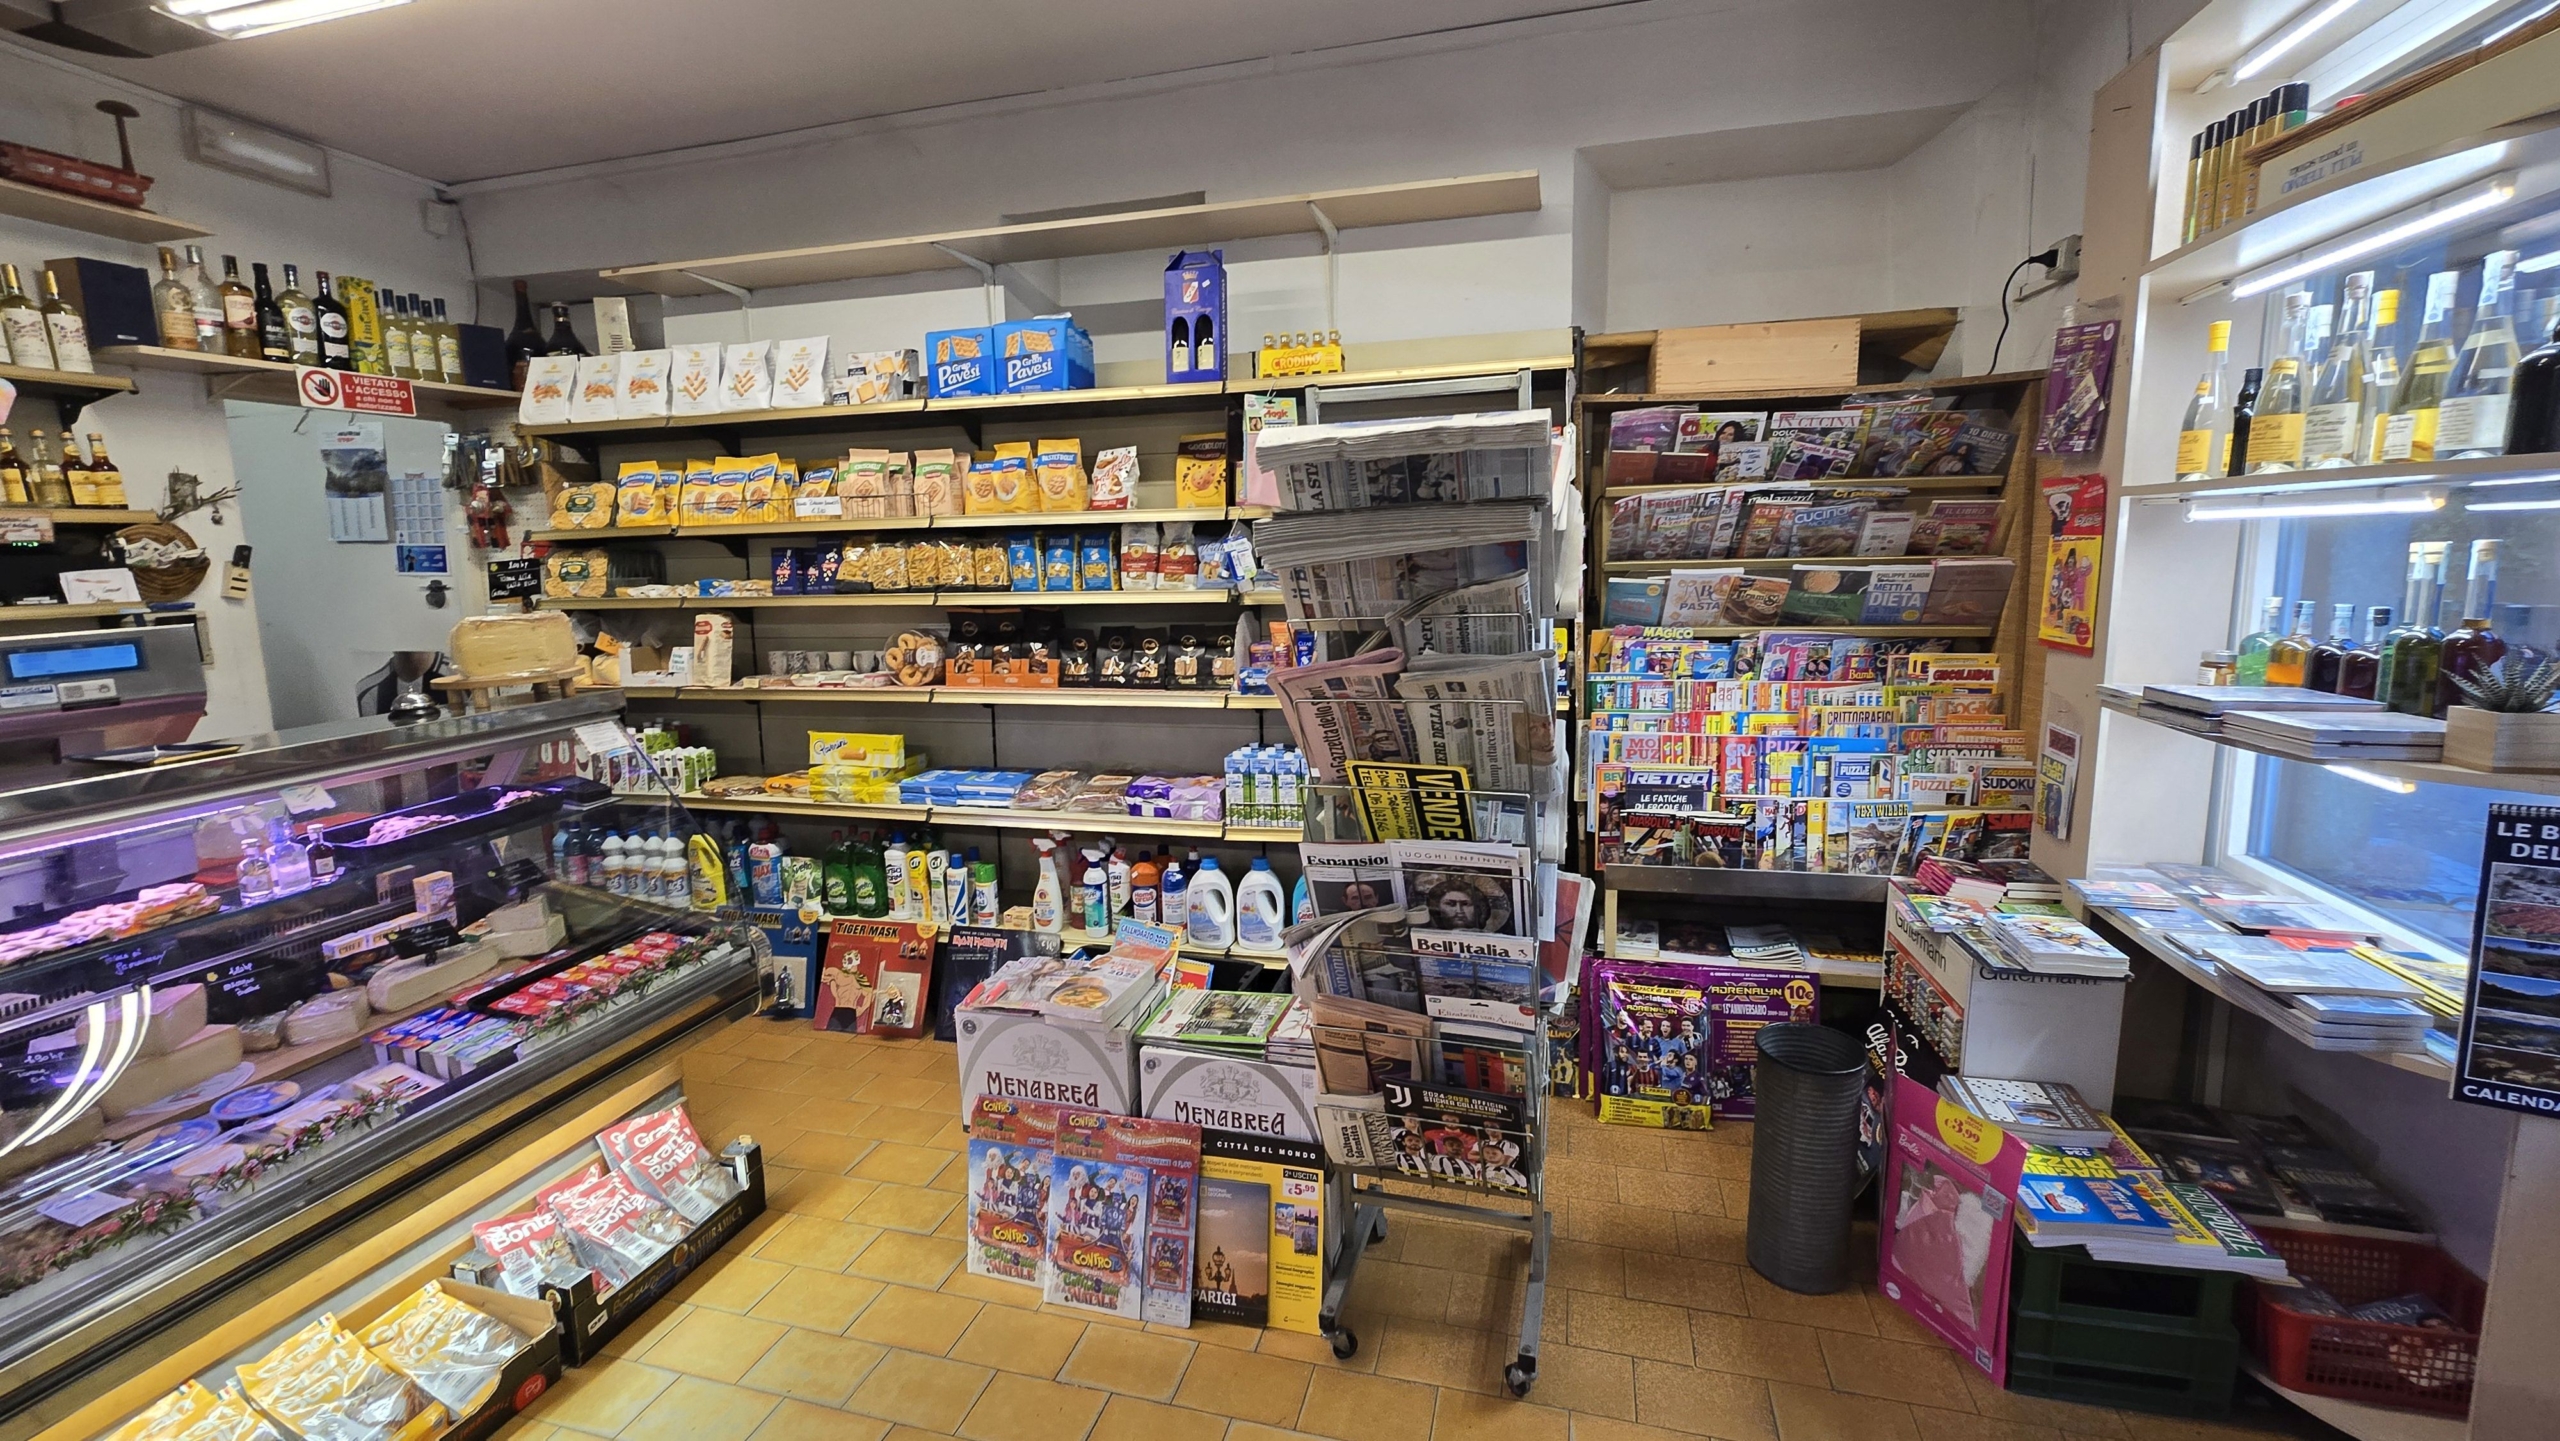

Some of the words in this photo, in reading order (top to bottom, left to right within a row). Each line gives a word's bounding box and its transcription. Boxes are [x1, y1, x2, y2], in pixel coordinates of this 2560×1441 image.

[1272, 352, 1323, 370] CRODINO
[938, 365, 980, 388] Pavesi
[1007, 358, 1053, 384] Pavesi
[352, 376, 398, 389] VIETATO
[345, 385, 408, 399] L'ACCESSO
[1968, 427, 1980, 435] 10
[1981, 429, 2010, 442] DIETE
[1311, 490, 1327, 511] LA
[1795, 508, 1850, 524] cucina
[1955, 508, 1986, 516] LIBRO
[1680, 602, 1721, 611] PASTA
[1867, 592, 1922, 608] DIETA
[1643, 626, 1695, 640] MAGICO
[1429, 704, 1446, 740] DELLA
[1321, 729, 1347, 768] Gazzetta
[1484, 728, 1499, 764] attacca:
[1839, 766, 1871, 776] PUZZLE
[1912, 781, 1955, 792] PUZZLE
[1982, 778, 2036, 790] SUDOKU
[1640, 794, 1651, 803] LE
[1652, 794, 1688, 803] FATICHE
[1416, 774, 1465, 840] VENDE
[1854, 806, 1874, 819] TEX
[1875, 803, 1909, 818] WILLER
[1628, 815, 1672, 829] DIABOLIK
[2497, 820, 2532, 839] LE
[1699, 825, 1743, 839] DIABOLIK
[909, 858, 921, 869] Cif
[930, 858, 943, 869] Cif
[1398, 851, 1448, 861] LUOGHI
[752, 863, 772, 878] AJAX
[793, 861, 813, 875] Svelto
[751, 912, 783, 925] MASK
[836, 922, 868, 936] TIGER
[868, 924, 899, 938] MASK
[1120, 926, 1154, 940] CALENDARIO
[1154, 933, 1170, 946] 2025
[1416, 938, 1512, 959] Bell'Italia
[1711, 986, 1783, 997] ADRENALYN
[1787, 985, 1815, 1001] 10€
[1865, 1023, 1891, 1056] alfa
[1867, 1048, 1884, 1070] SPORT
[986, 1071, 1100, 1108] MENABREA
[1422, 1090, 1470, 1105] 2024-2025
[1472, 1099, 1509, 1112] OFFICIAL
[1423, 1097, 1456, 1107] STICKER
[1456, 1100, 1502, 1114] COLLECTION
[1174, 1100, 1286, 1138] MENABREA
[1340, 1125, 1355, 1158] Cultura
[1351, 1123, 1366, 1160] Identità
[1898, 1133, 1921, 1156] Barbie
[1217, 1140, 1249, 1151] CITTÀ
[1254, 1146, 1274, 1155] DEL
[1279, 1148, 1316, 1160] MONDO
[1292, 1172, 1318, 1182] USCITA
[993, 1226, 1030, 1244] CONTRO
[1072, 1250, 1113, 1269] CONTRO
[1192, 1288, 1238, 1306] PARIGI
